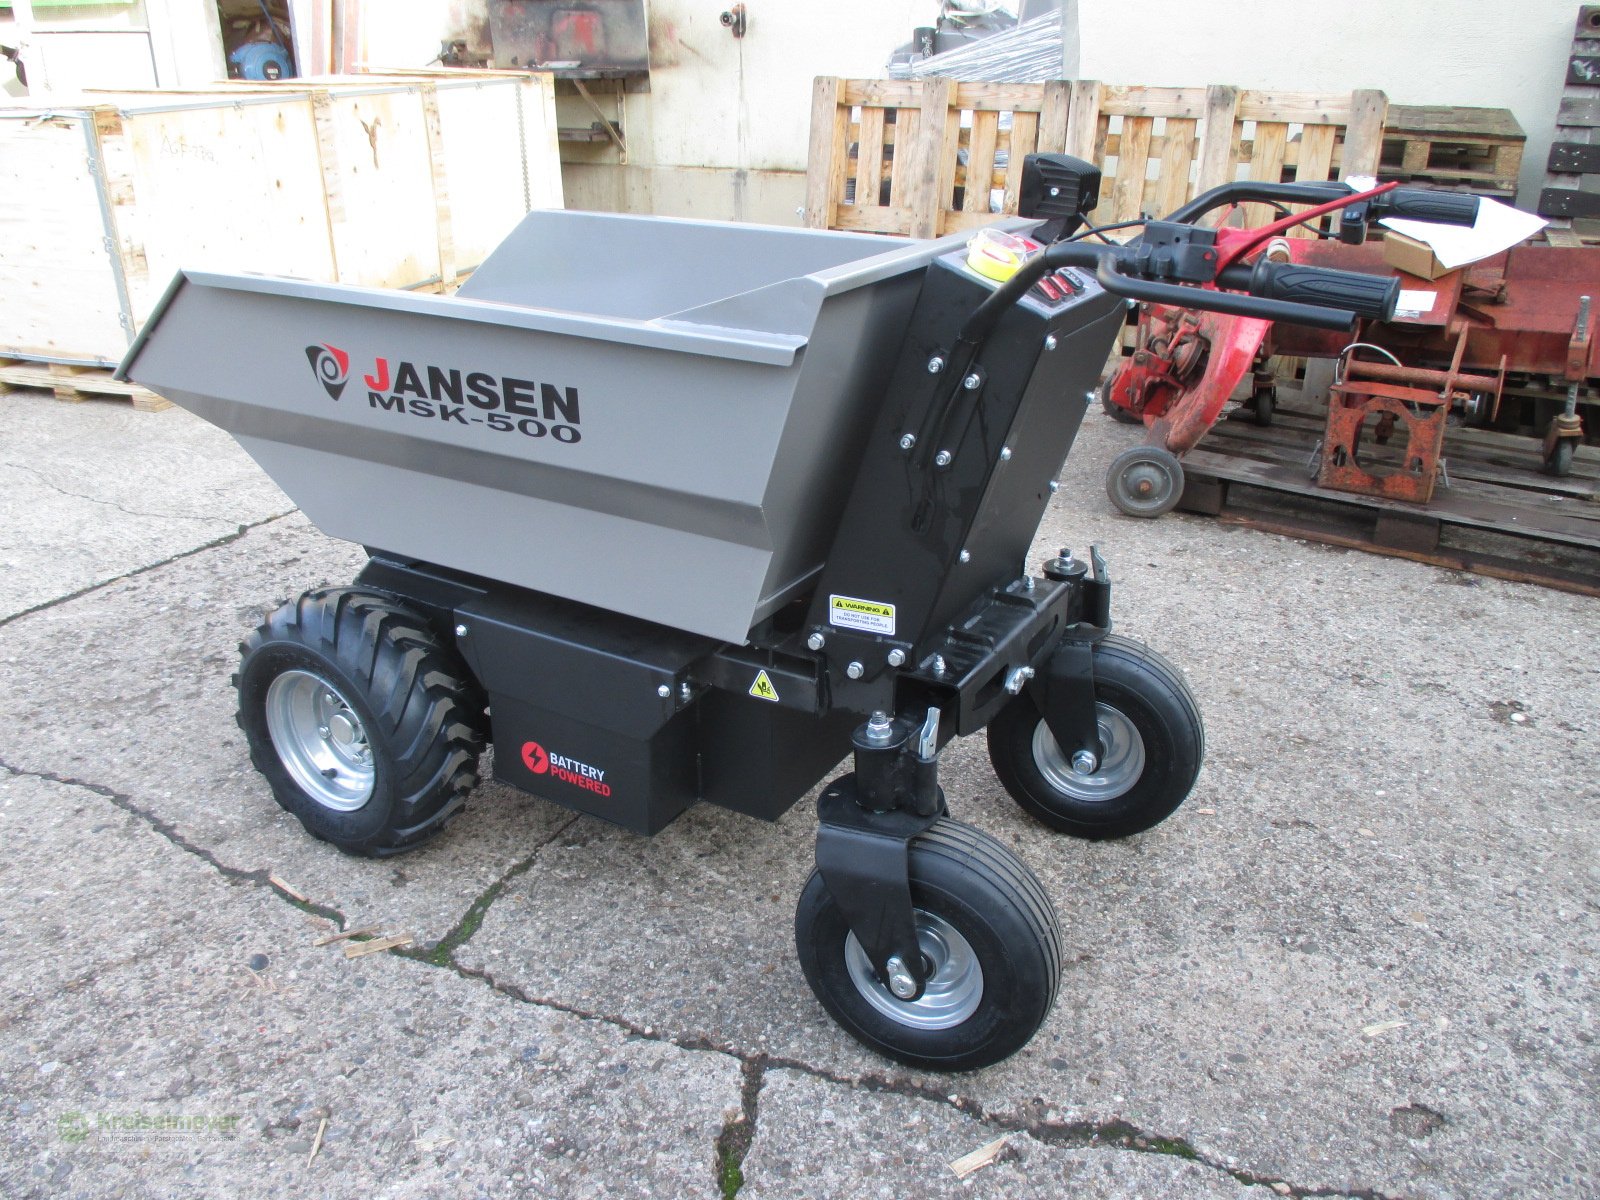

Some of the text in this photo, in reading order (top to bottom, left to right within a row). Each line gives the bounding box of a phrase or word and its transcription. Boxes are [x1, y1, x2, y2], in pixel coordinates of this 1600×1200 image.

[364, 357, 580, 424] JANSEN
[367, 391, 582, 444] MSK-500
[845, 603, 880, 613] WARNING
[550, 752, 604, 781] BATTERY
[551, 765, 611, 796] POWERED
